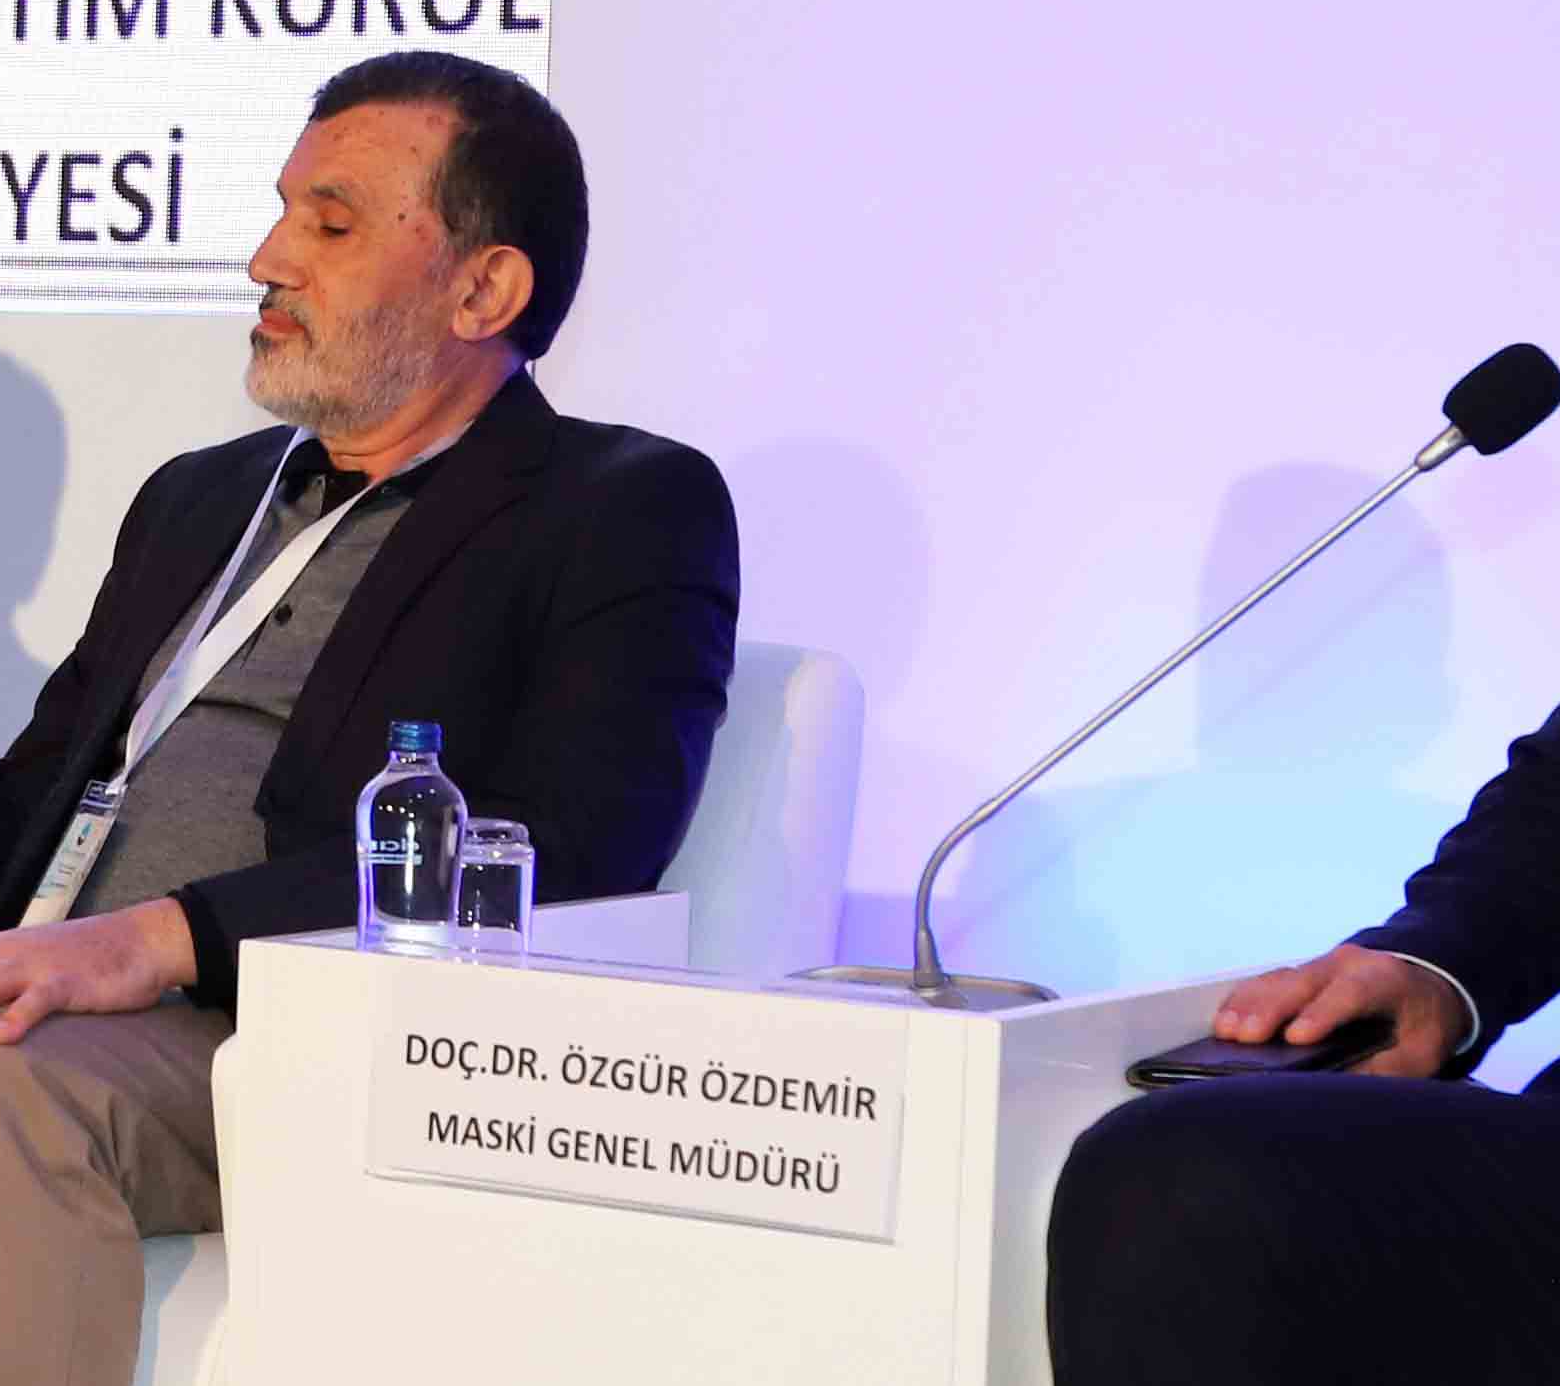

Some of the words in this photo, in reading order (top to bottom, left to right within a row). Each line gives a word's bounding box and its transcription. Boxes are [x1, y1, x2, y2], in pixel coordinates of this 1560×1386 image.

[404, 1033, 548, 1080] DOÇ.DR.
[560, 1044, 689, 1098] ÖZGÜR
[699, 1060, 877, 1121] ÖZDEMİR
[426, 1110, 537, 1155] MASKİ
[546, 1126, 658, 1171] GENEL
[668, 1138, 841, 1195] MÜDÜRÜ
